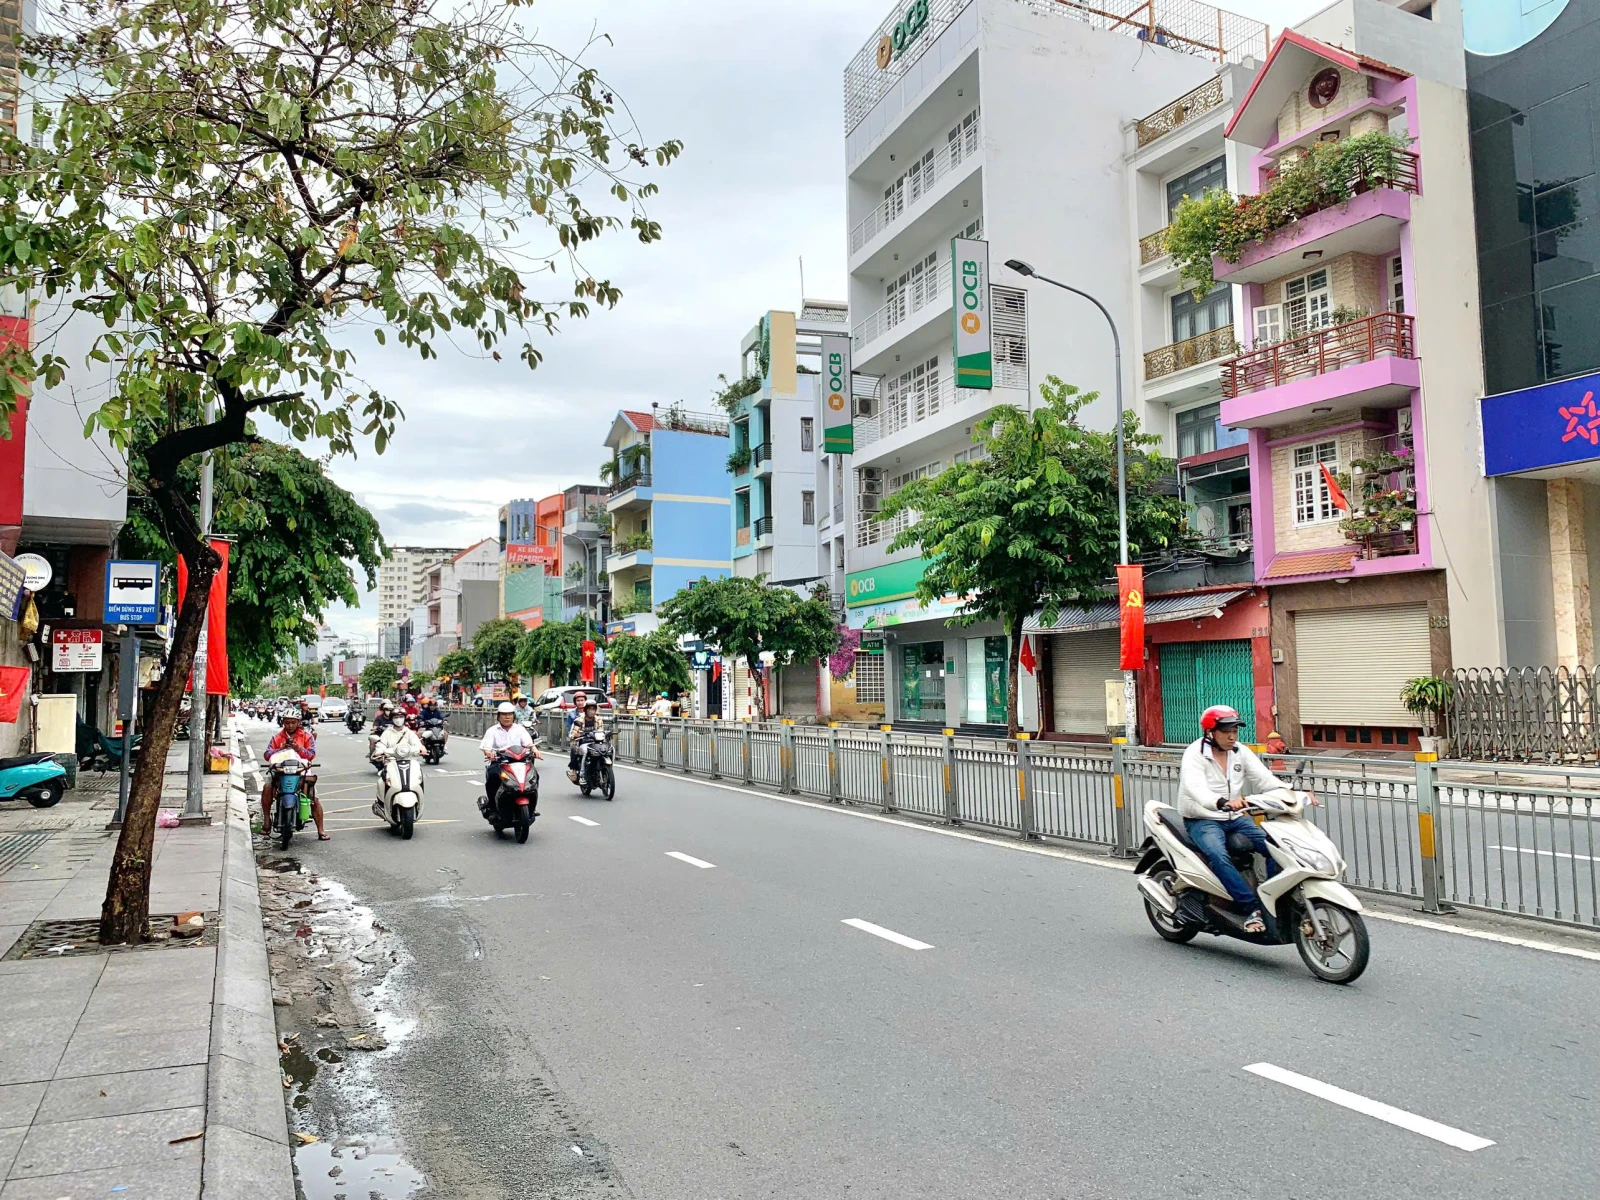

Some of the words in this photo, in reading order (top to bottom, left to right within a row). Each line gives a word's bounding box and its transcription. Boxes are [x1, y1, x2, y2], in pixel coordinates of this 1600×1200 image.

[891, 0, 929, 51] OCB
[962, 260, 978, 310] OCB
[829, 353, 842, 392] OCB
[858, 577, 875, 593] OCB
